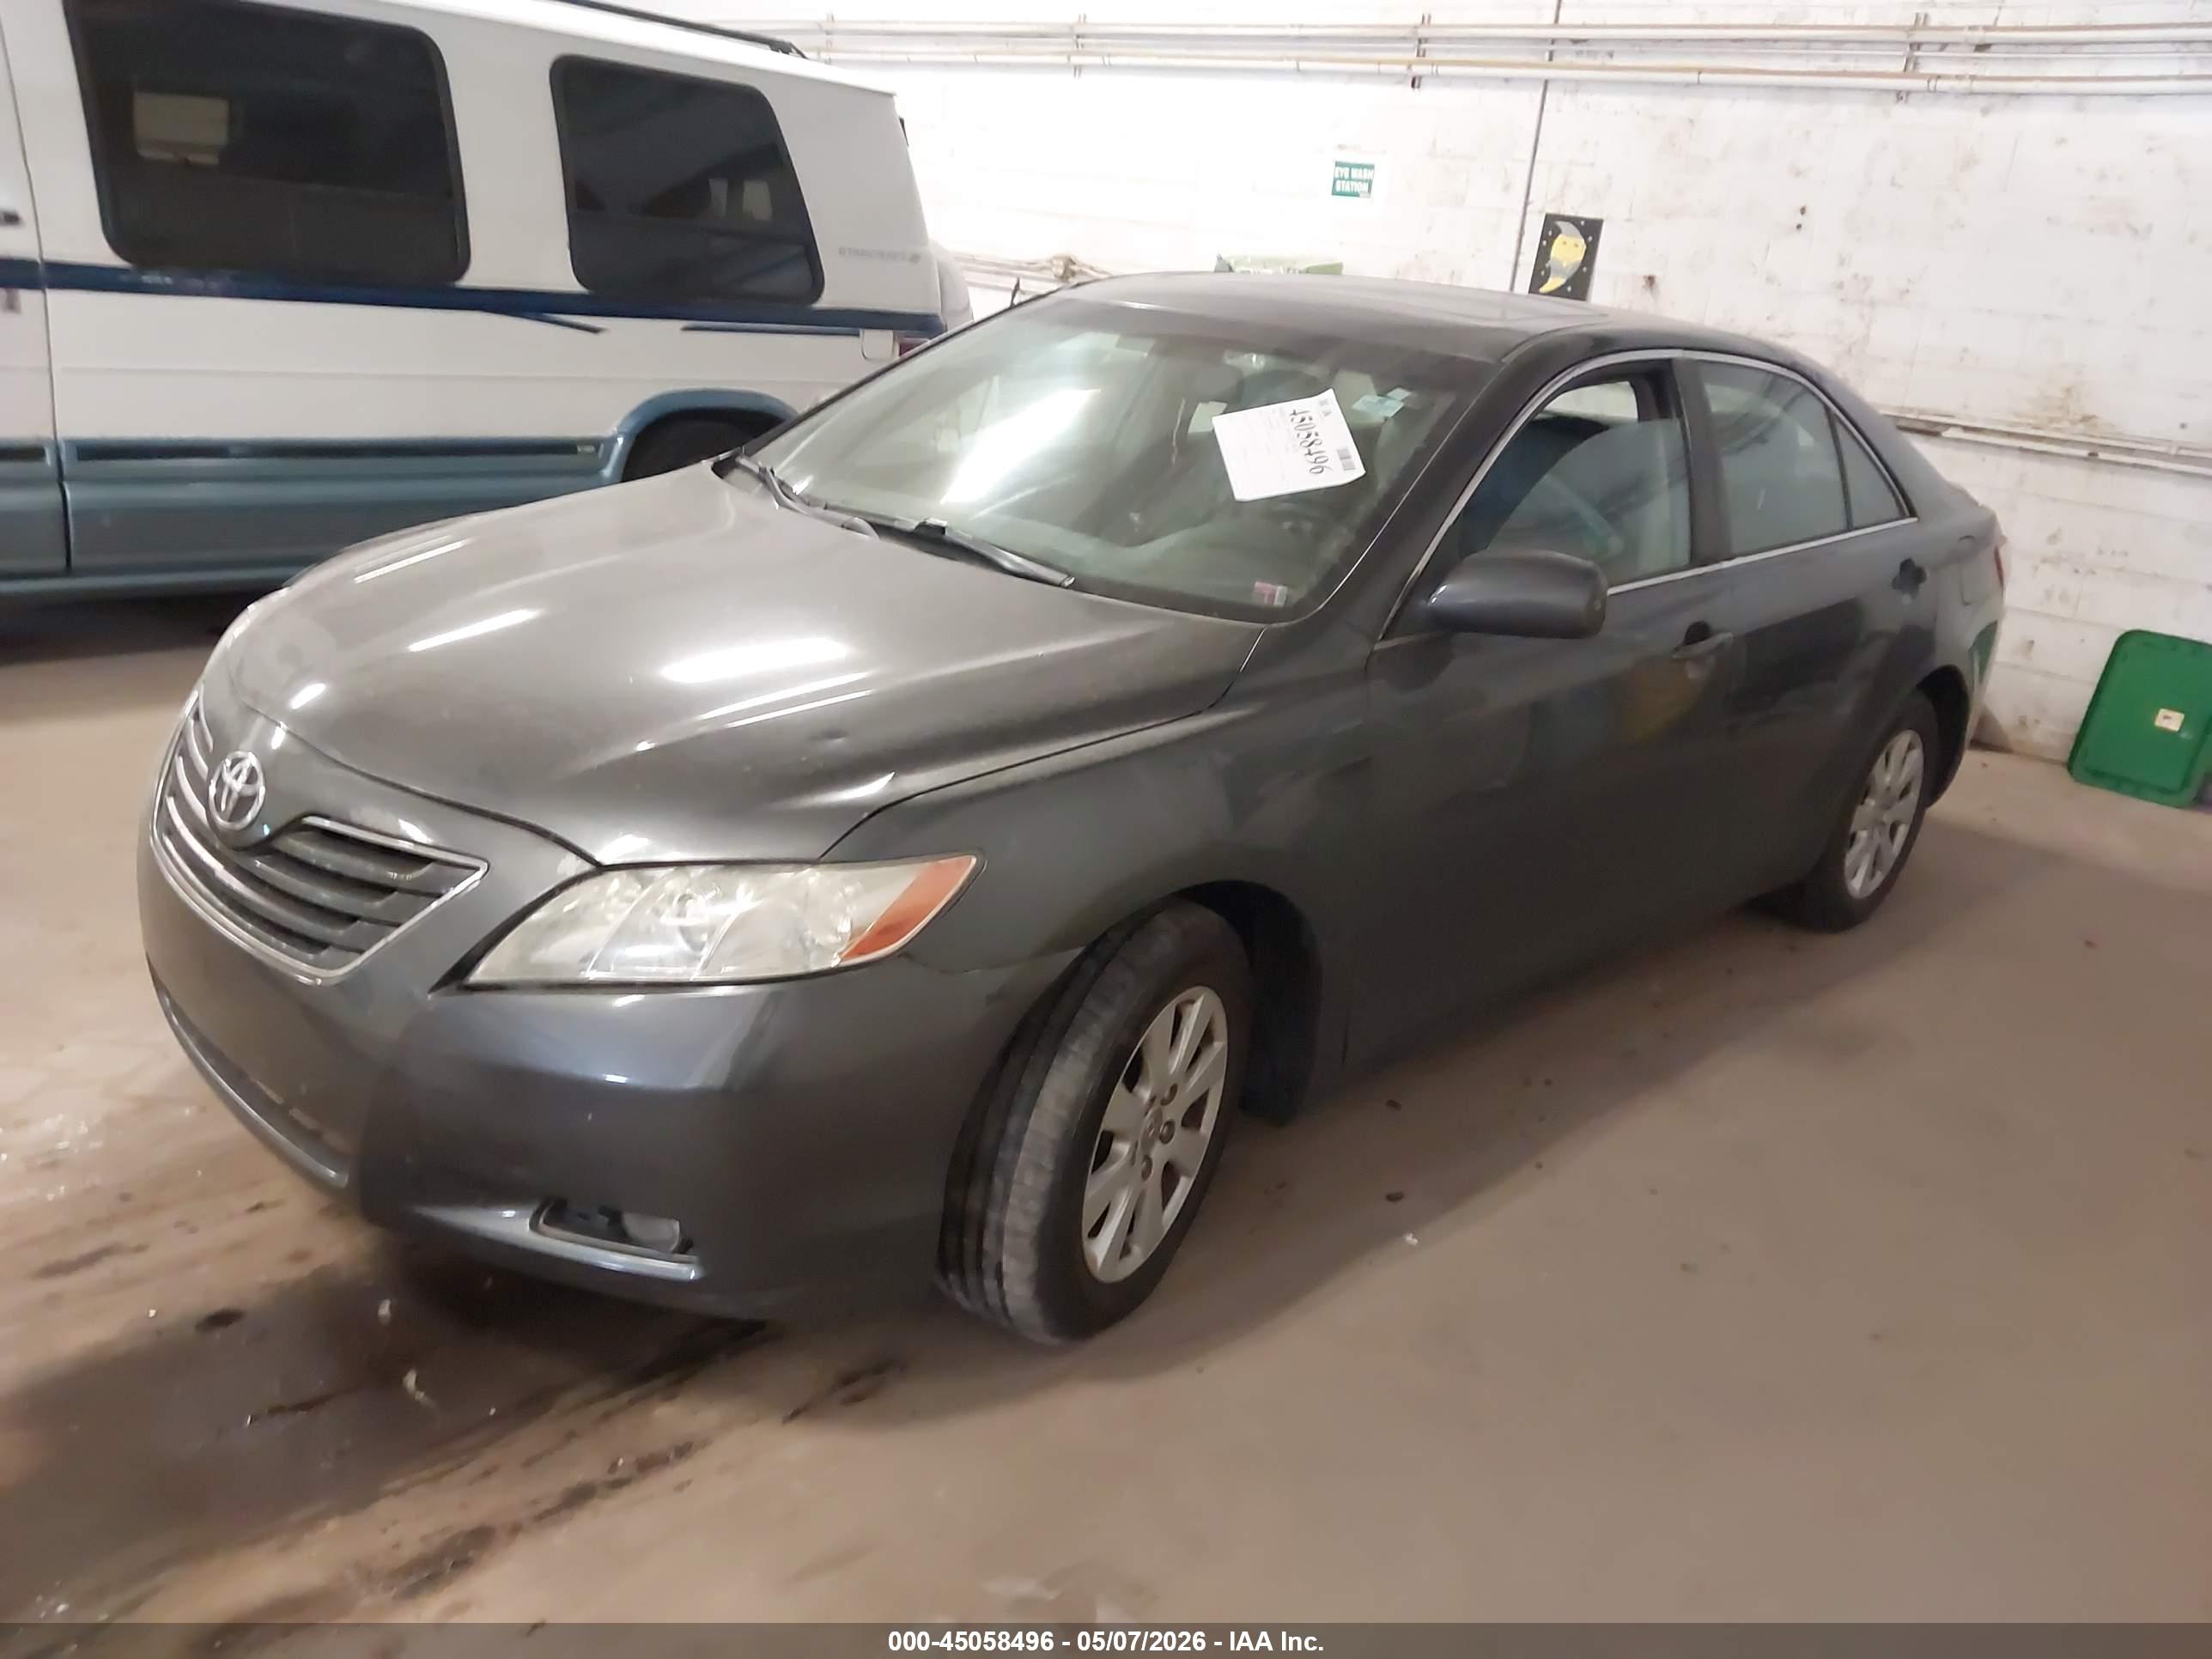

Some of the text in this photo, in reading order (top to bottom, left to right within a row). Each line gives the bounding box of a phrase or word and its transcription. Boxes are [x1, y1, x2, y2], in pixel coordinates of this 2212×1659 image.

[1334, 166, 1374, 180] EYE WASH
[1335, 179, 1369, 193] STATION
[1291, 408, 1333, 476] 45058496
